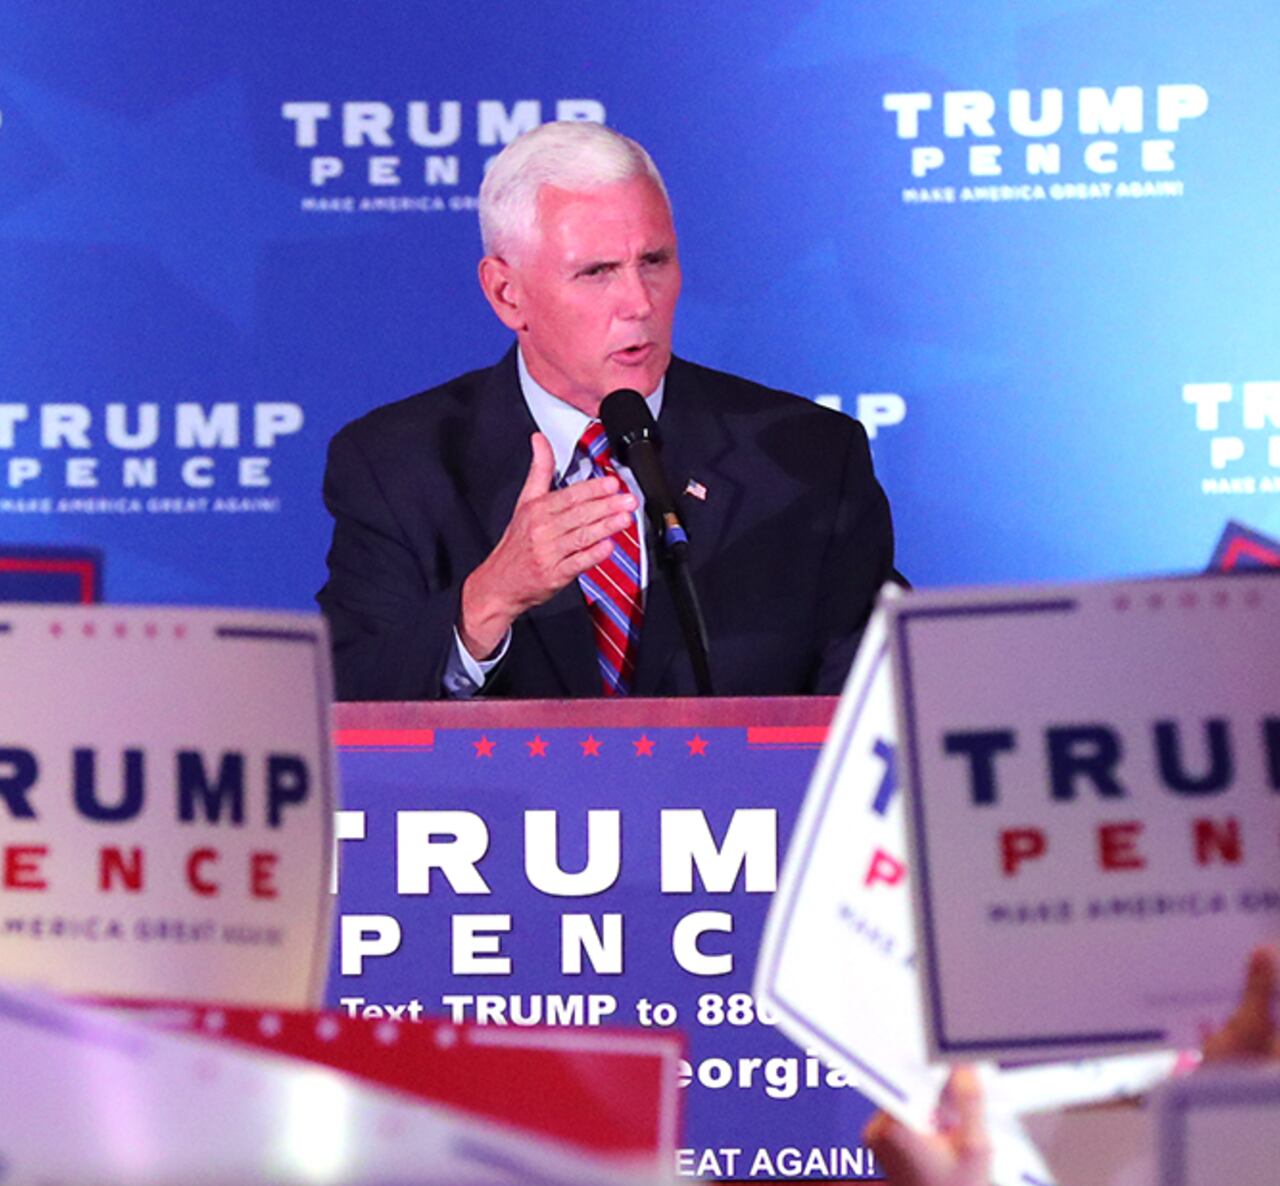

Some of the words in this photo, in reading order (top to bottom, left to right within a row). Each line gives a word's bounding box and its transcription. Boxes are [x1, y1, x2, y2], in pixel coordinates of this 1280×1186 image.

[883, 84, 1209, 139] TRUMP
[311, 155, 496, 186] PEN
[911, 139, 1175, 177] PENCE
[960, 184, 1046, 201] AMERICA
[7, 457, 271, 488] PENCE
[442, 994, 617, 1026] TRUMP
[636, 998, 677, 1026] to
[749, 1147, 876, 1177] AGAIN!
